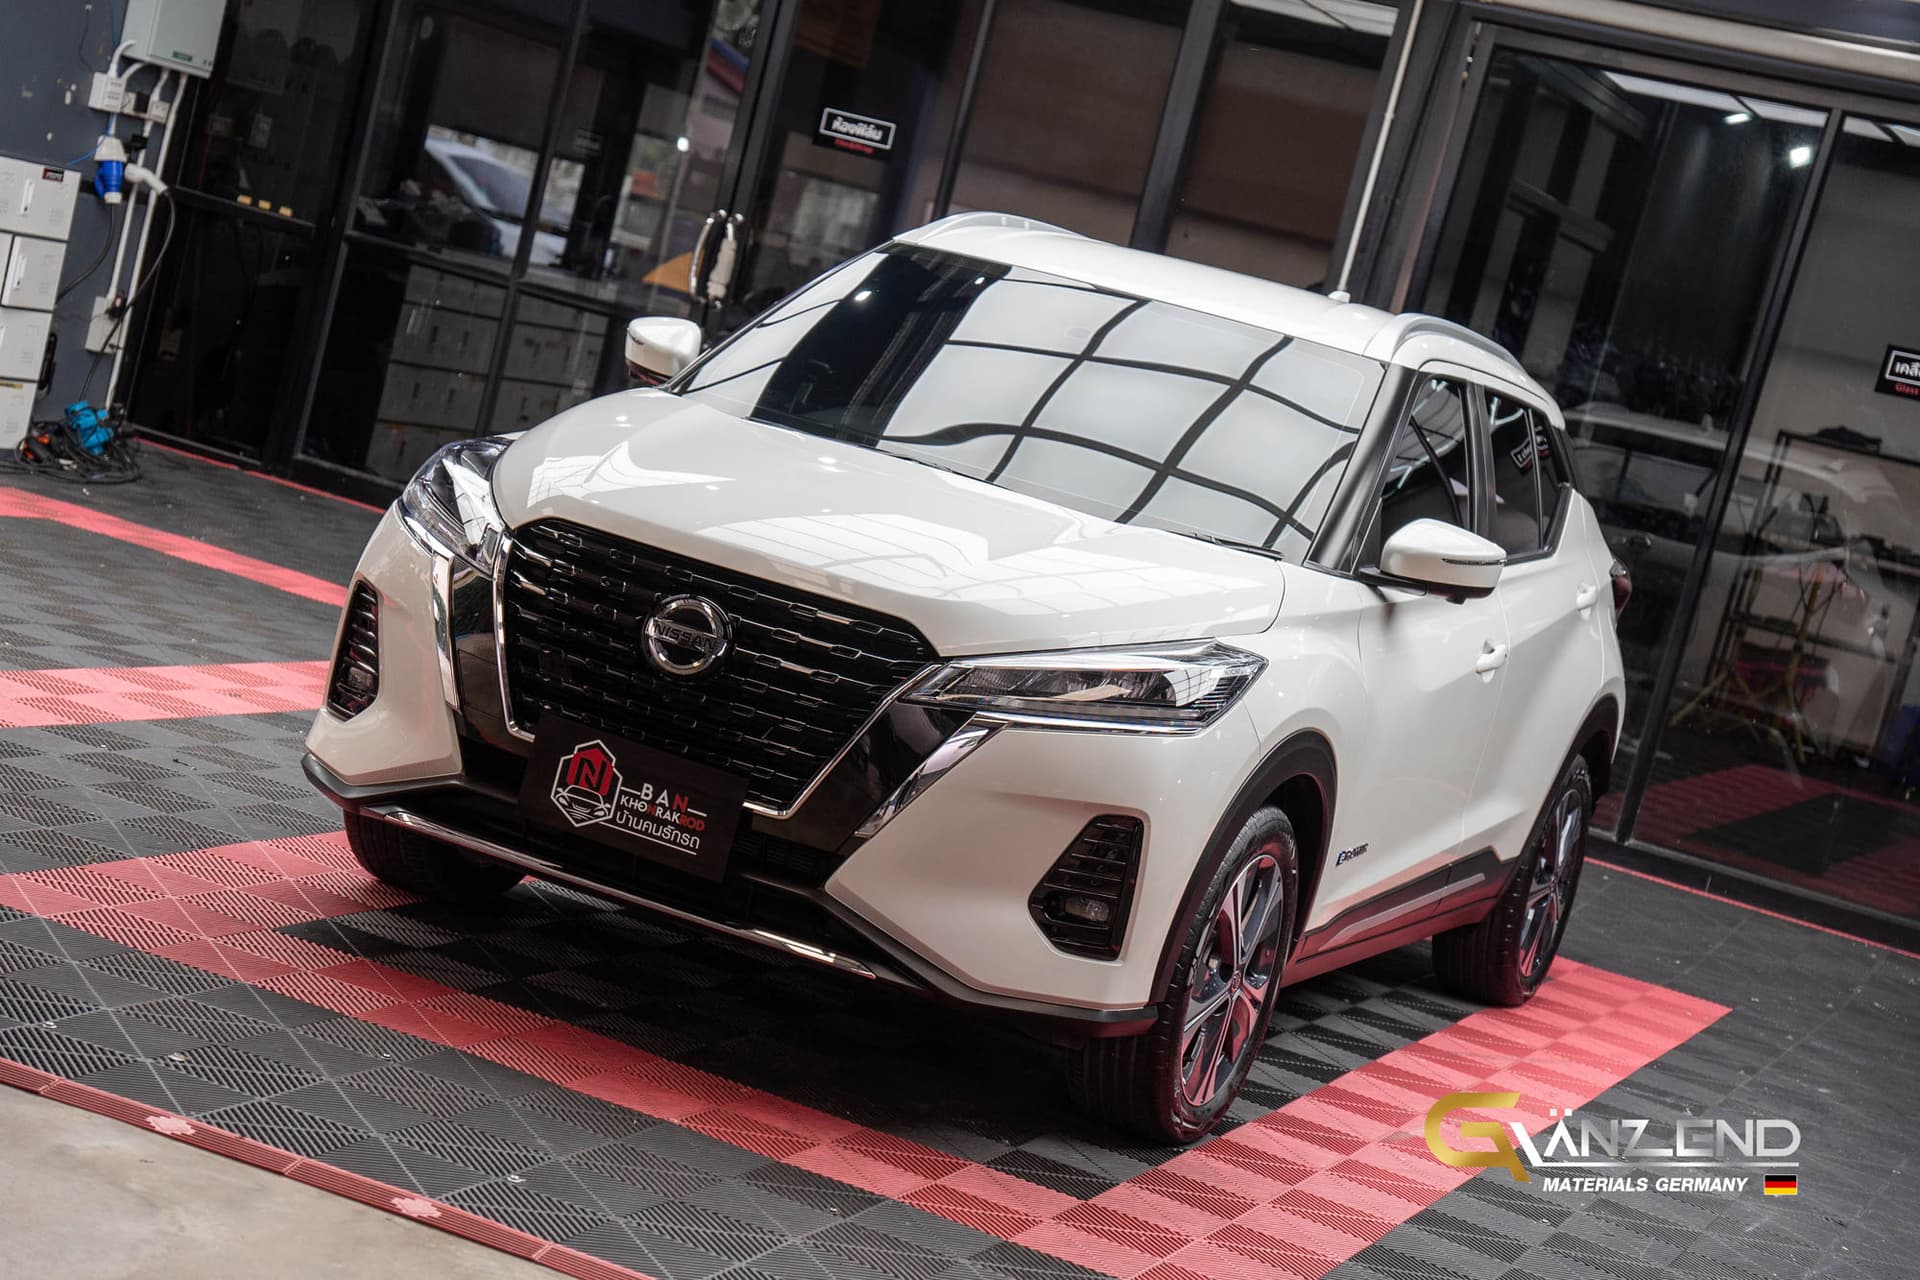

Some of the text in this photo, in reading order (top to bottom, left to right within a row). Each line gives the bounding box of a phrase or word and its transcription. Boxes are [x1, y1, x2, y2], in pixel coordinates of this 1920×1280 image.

[655, 622, 715, 650] NISSAN
[641, 782, 689, 812] BAN
[615, 810, 700, 849] บ้านคนรักรถ
